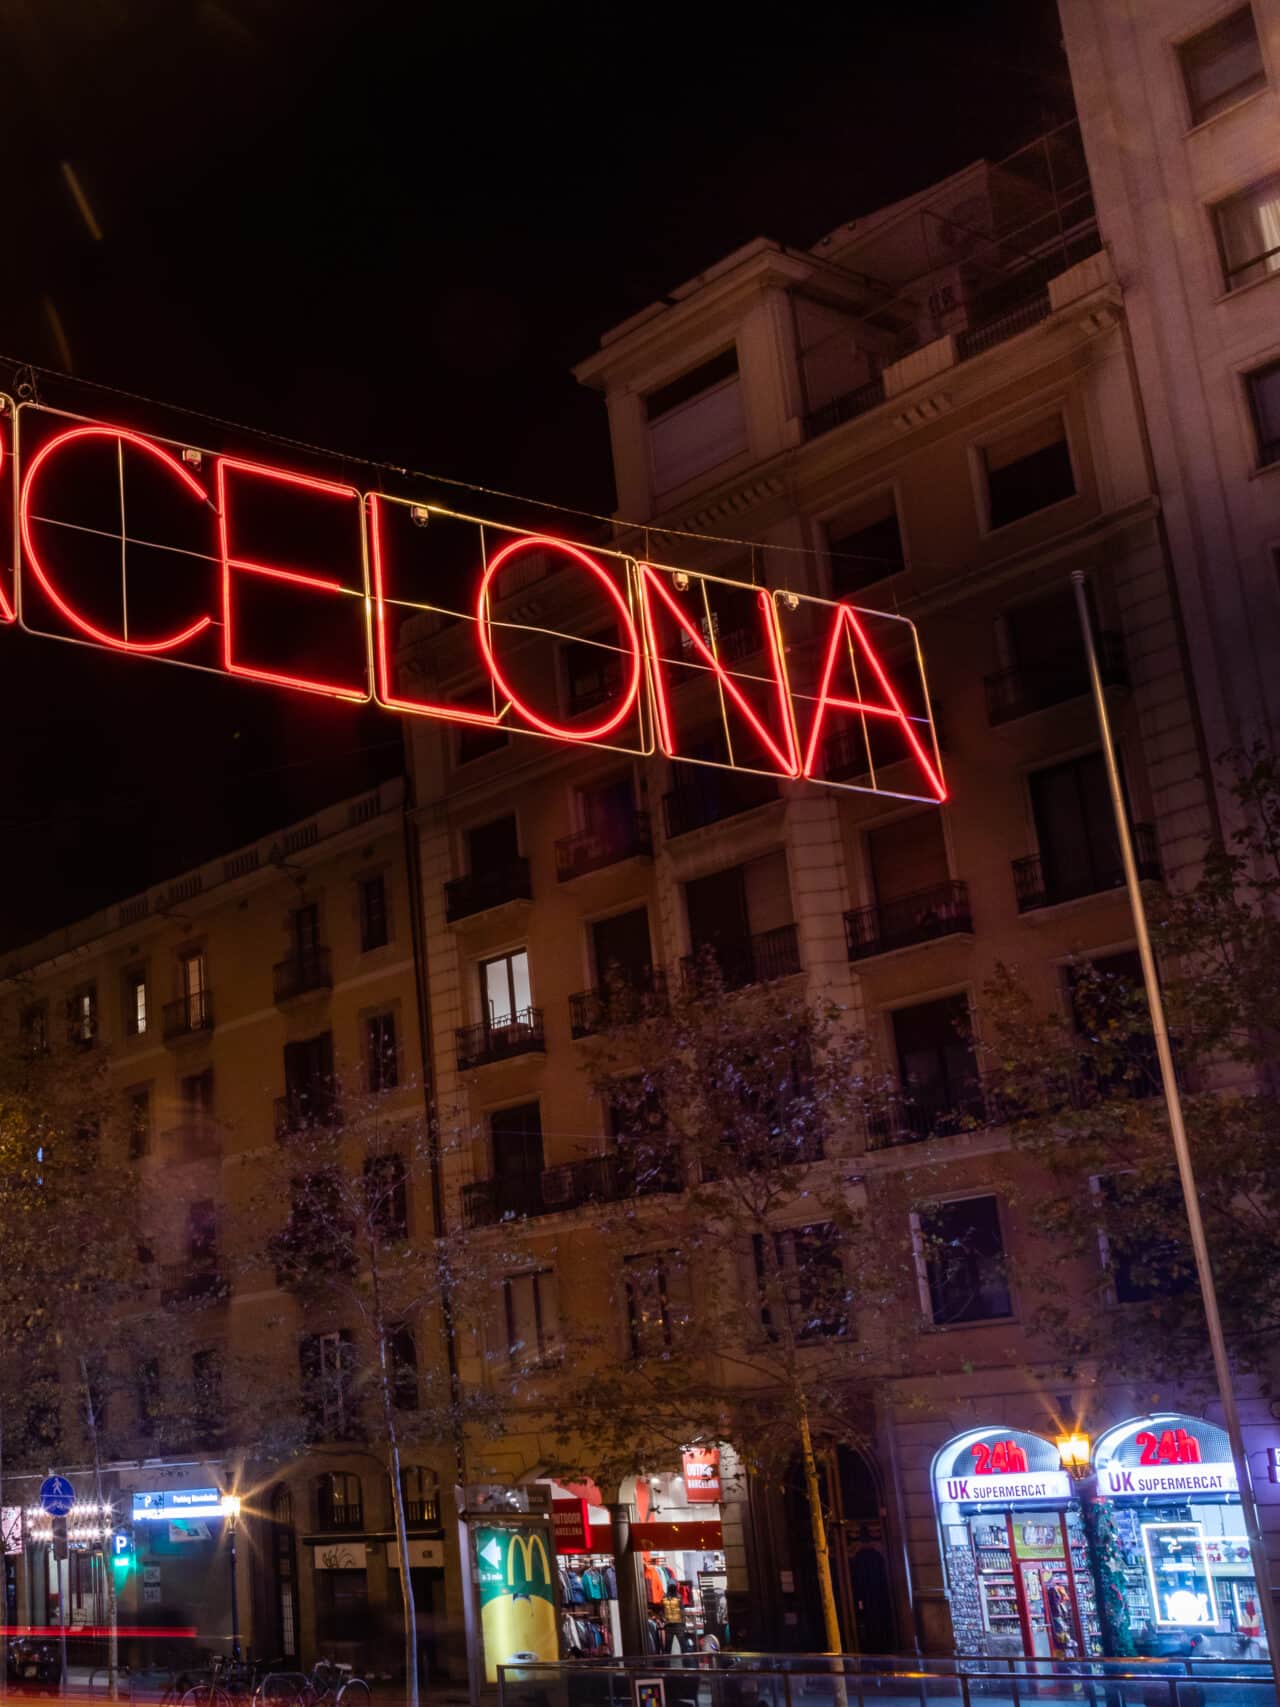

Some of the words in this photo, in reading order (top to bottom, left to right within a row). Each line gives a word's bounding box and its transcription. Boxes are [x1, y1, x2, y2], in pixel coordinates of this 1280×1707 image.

[971, 1440, 1029, 1474] 24h
[1136, 1428, 1201, 1465] 24h
[947, 1480, 970, 1500] UK
[973, 1484, 1047, 1499] SUPERMERCAT
[1108, 1471, 1136, 1492] UK
[1138, 1475, 1223, 1491] SUPERMERCAT
[116, 1536, 127, 1554] P
